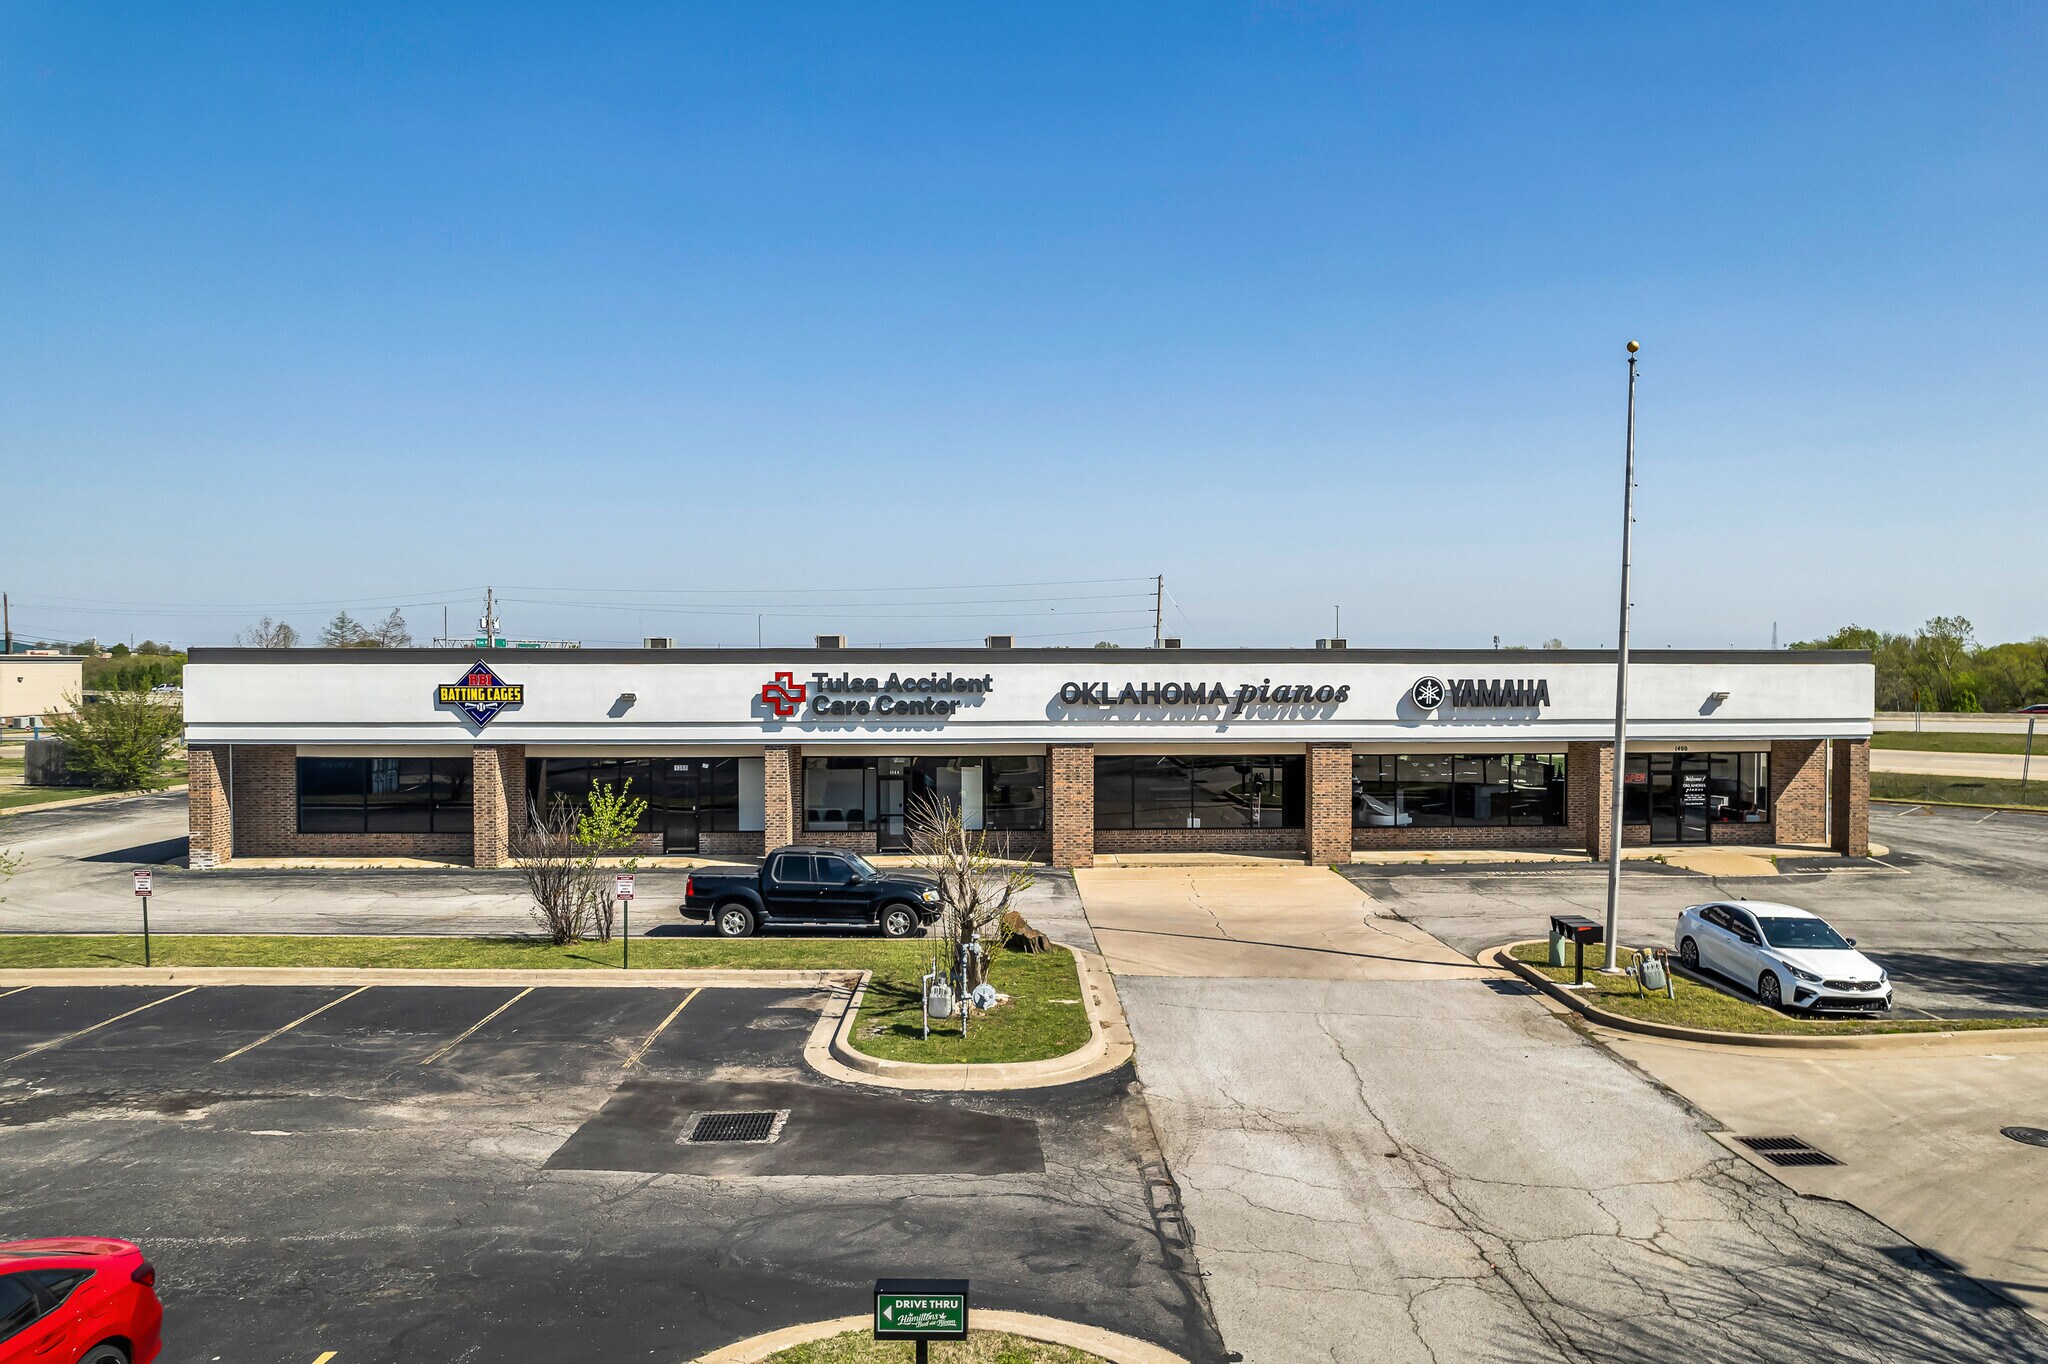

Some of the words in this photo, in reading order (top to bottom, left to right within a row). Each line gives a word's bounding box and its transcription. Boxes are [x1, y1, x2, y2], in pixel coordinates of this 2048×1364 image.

[468, 674, 492, 686] RBI
[812, 672, 879, 692] Tulsa
[884, 672, 993, 693] Accident
[440, 687, 485, 701] BATTING
[487, 687, 521, 701] CAGES
[1060, 682, 1230, 705] OKLAHOMA
[1232, 678, 1351, 714] pianos
[1447, 679, 1551, 707] YAMAHA
[812, 695, 870, 716] Care
[876, 695, 960, 716] Center
[1625, 772, 1646, 784] OPEN
[895, 1300, 927, 1309] DRIVE
[929, 1300, 958, 1309] THRU
